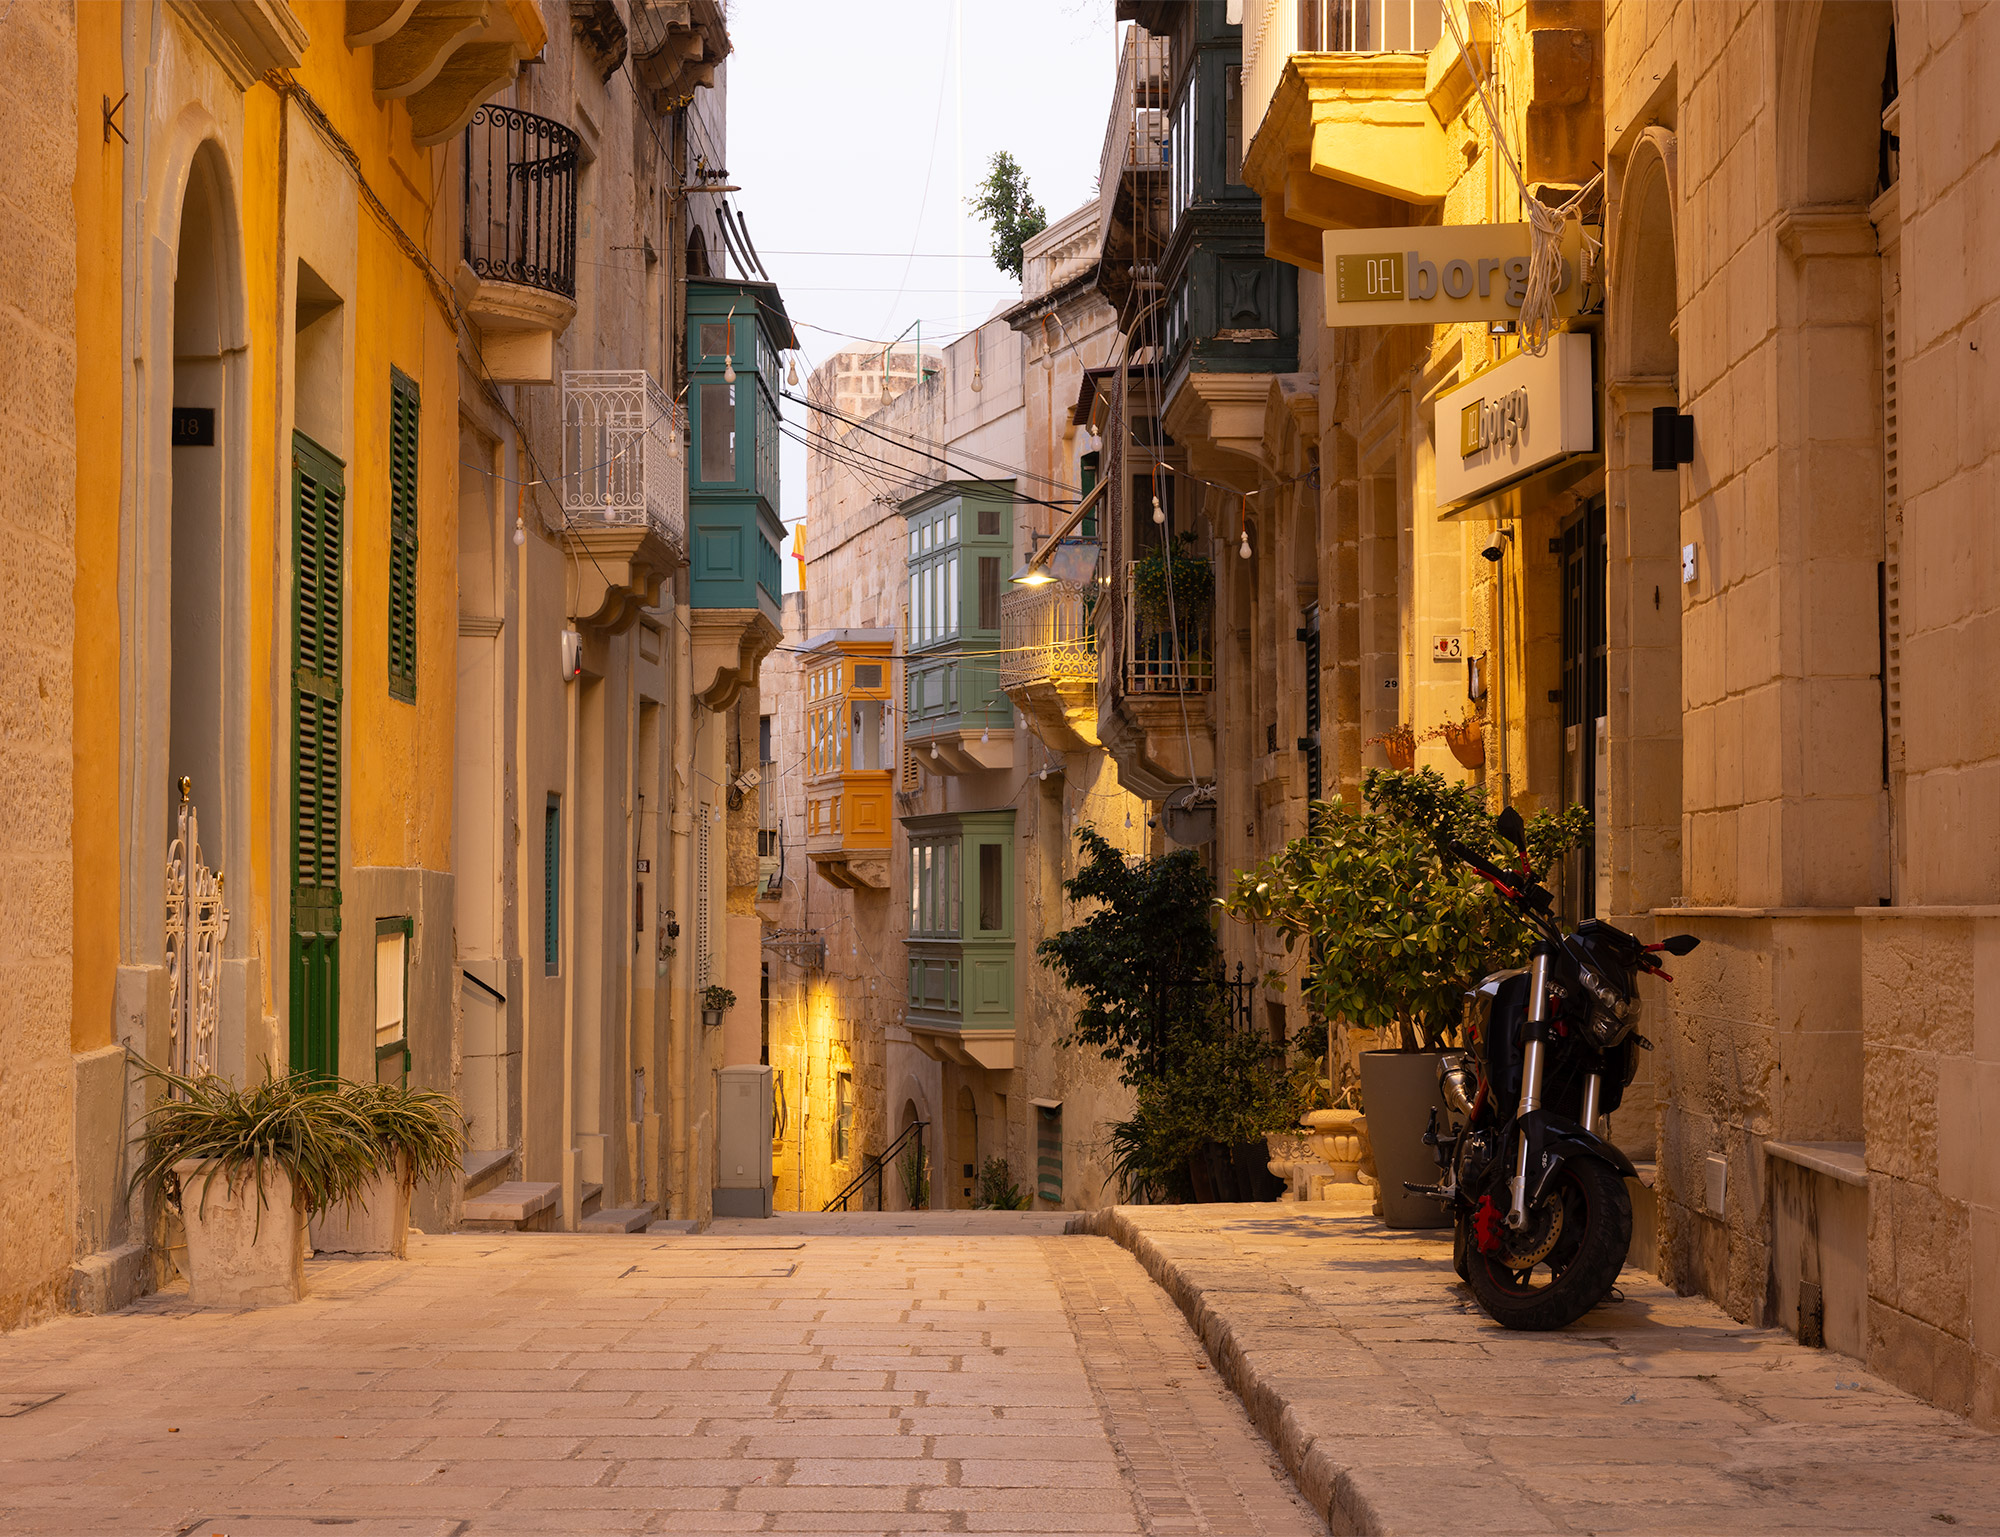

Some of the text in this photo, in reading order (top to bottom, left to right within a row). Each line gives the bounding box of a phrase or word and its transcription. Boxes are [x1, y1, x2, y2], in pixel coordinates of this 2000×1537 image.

[1367, 258, 1402, 295] DEL
[178, 418, 199, 436] 18
[1478, 384, 1529, 449] borgo
[1384, 680, 1398, 688] 29
